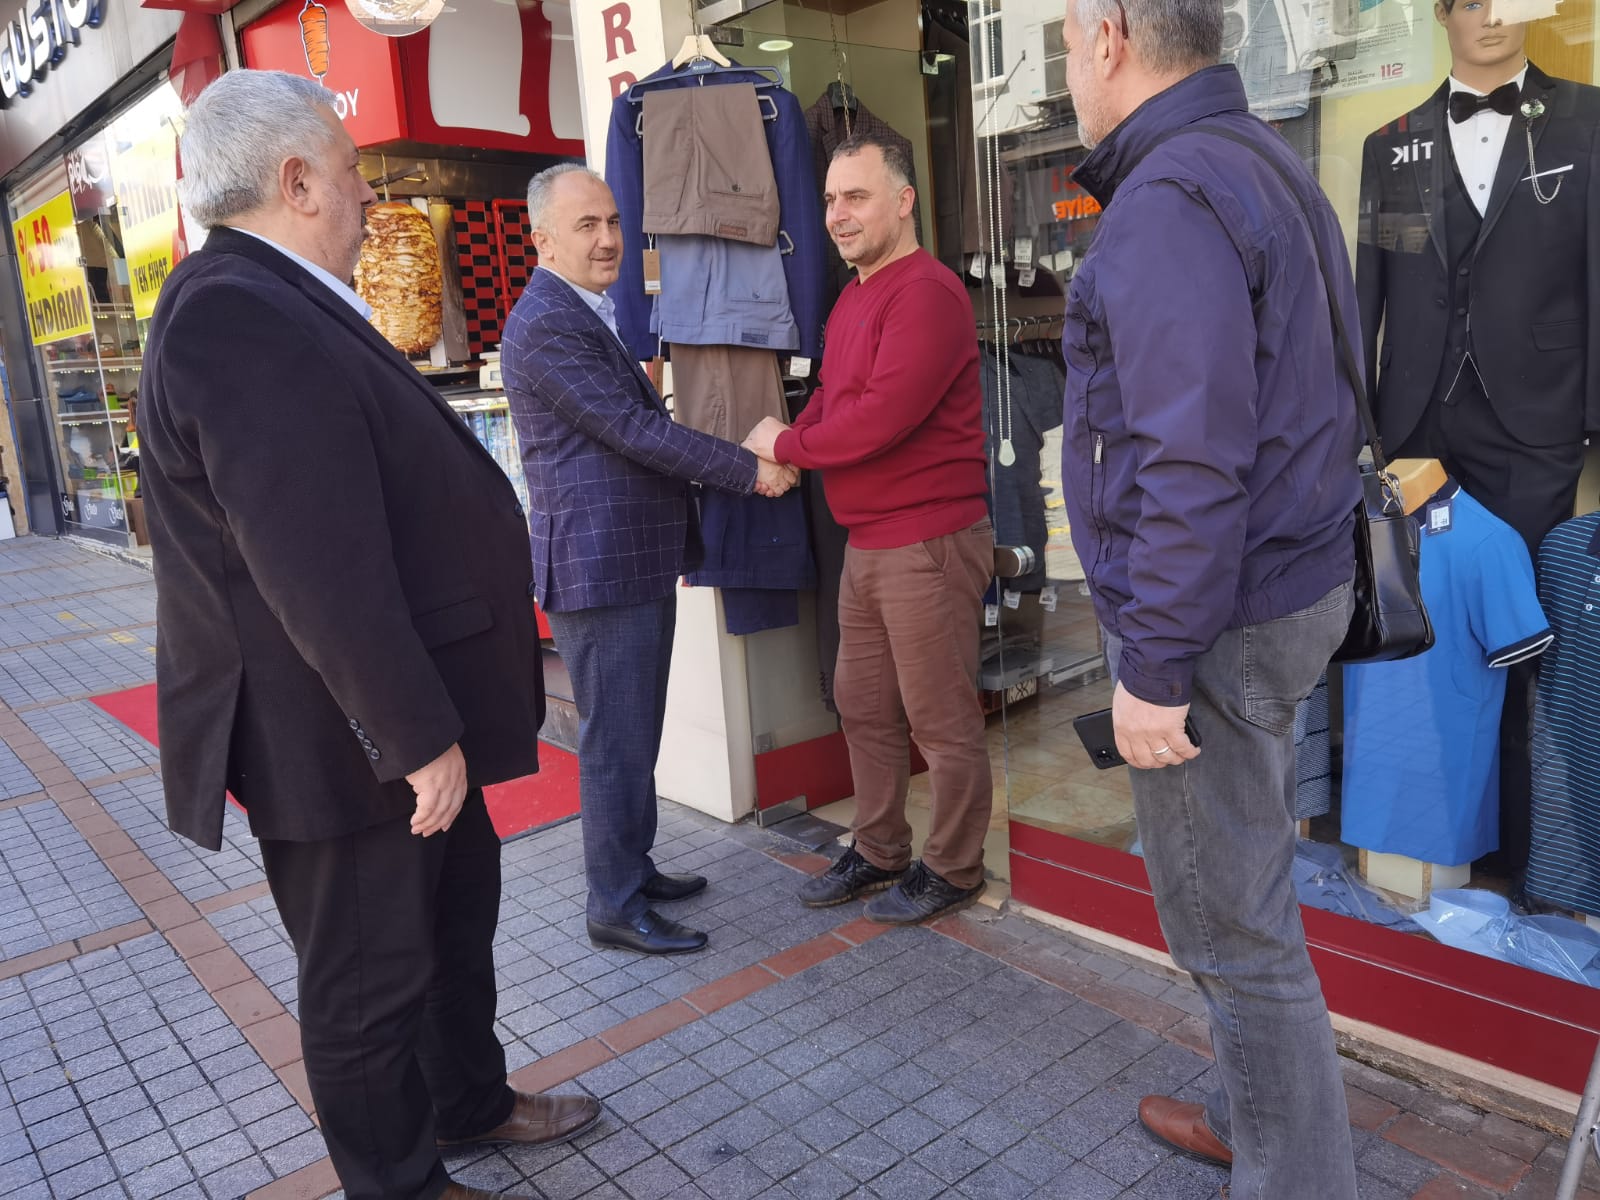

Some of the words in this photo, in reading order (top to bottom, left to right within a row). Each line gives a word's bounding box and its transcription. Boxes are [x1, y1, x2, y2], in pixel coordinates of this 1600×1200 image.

[1380, 62, 1404, 78] 112
[133, 265, 149, 295] TEK
[28, 278, 89, 338] İNDİRİM
